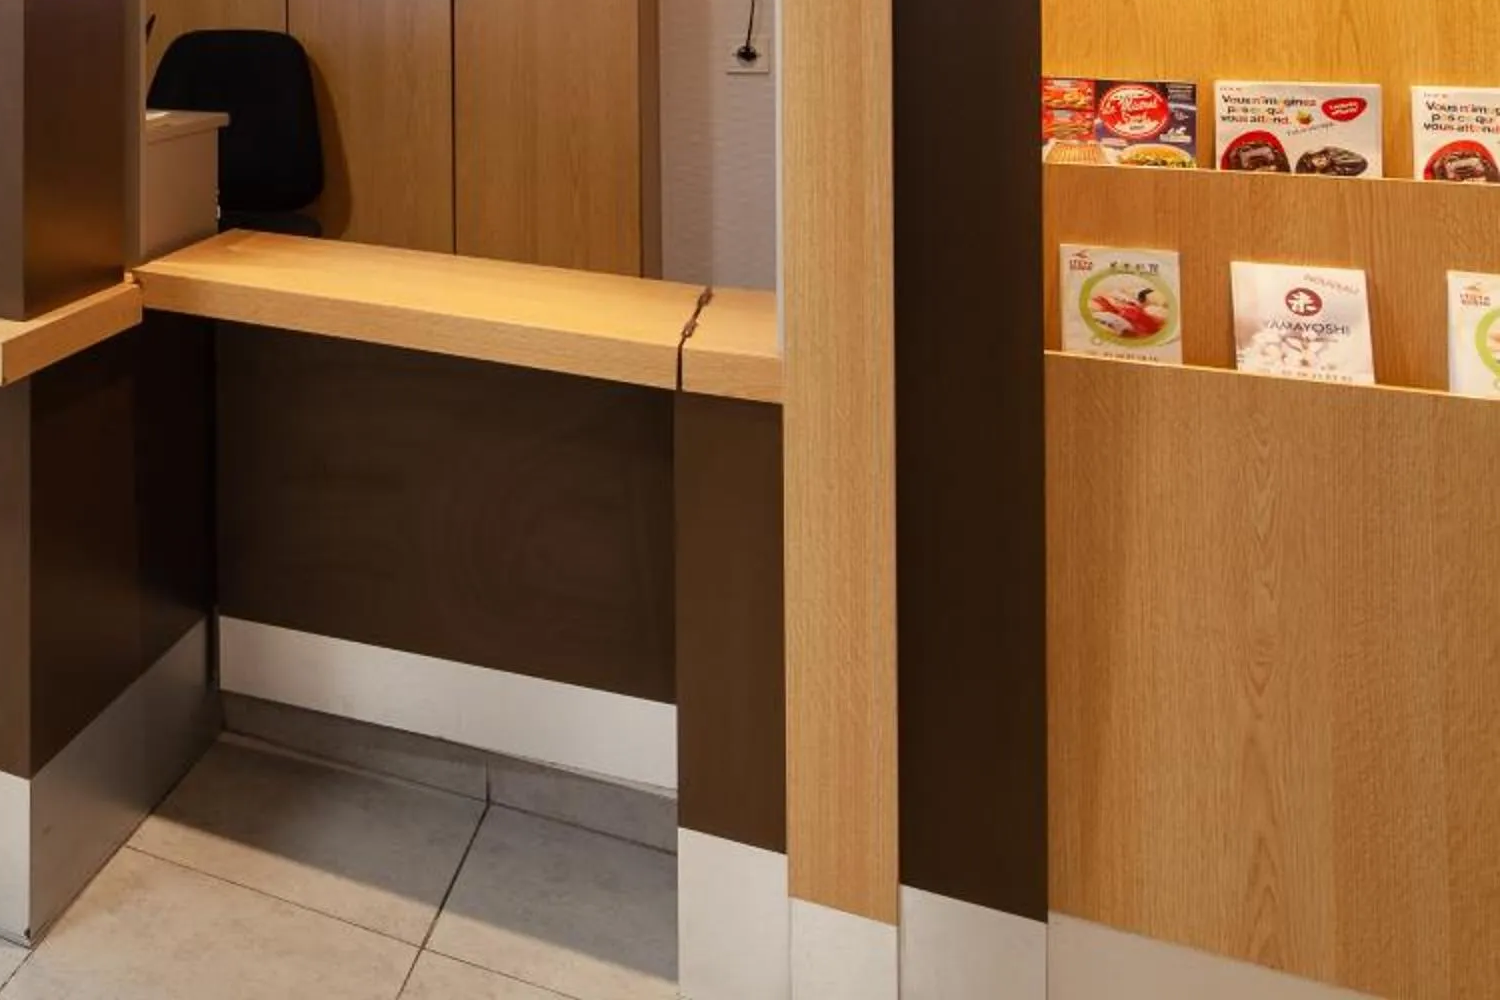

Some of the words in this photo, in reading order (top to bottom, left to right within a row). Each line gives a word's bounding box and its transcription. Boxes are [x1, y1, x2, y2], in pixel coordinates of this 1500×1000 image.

[1251, 95, 1317, 107] n'imginez
[1425, 101, 1457, 113] Vous
[1423, 122, 1455, 132] vous
